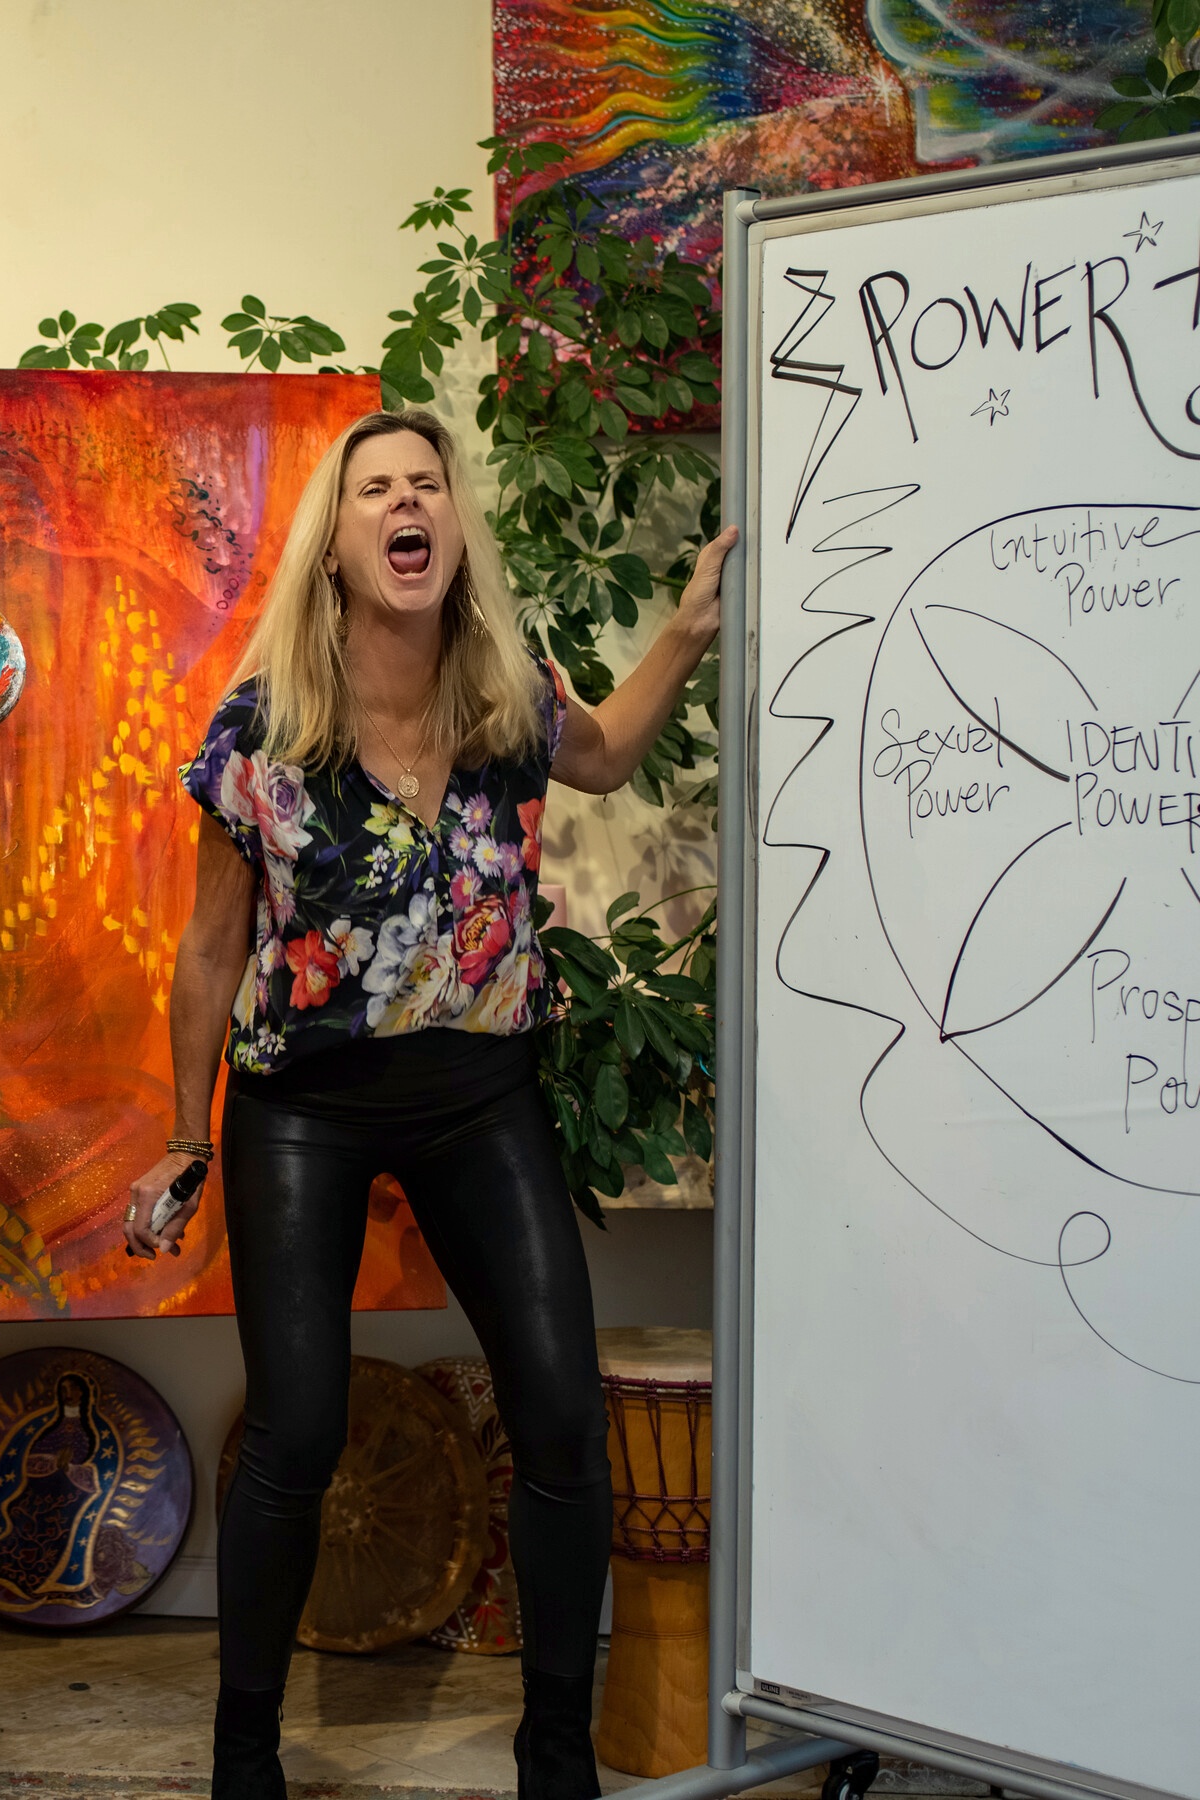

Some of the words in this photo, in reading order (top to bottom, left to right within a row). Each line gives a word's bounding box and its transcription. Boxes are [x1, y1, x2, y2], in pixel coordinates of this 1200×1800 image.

[858, 255, 1200, 460] POWER
[990, 510, 1200, 573] Intuitive
[1054, 562, 1181, 626] Power
[872, 696, 1004, 777] Sexual
[893, 759, 1010, 839] Power
